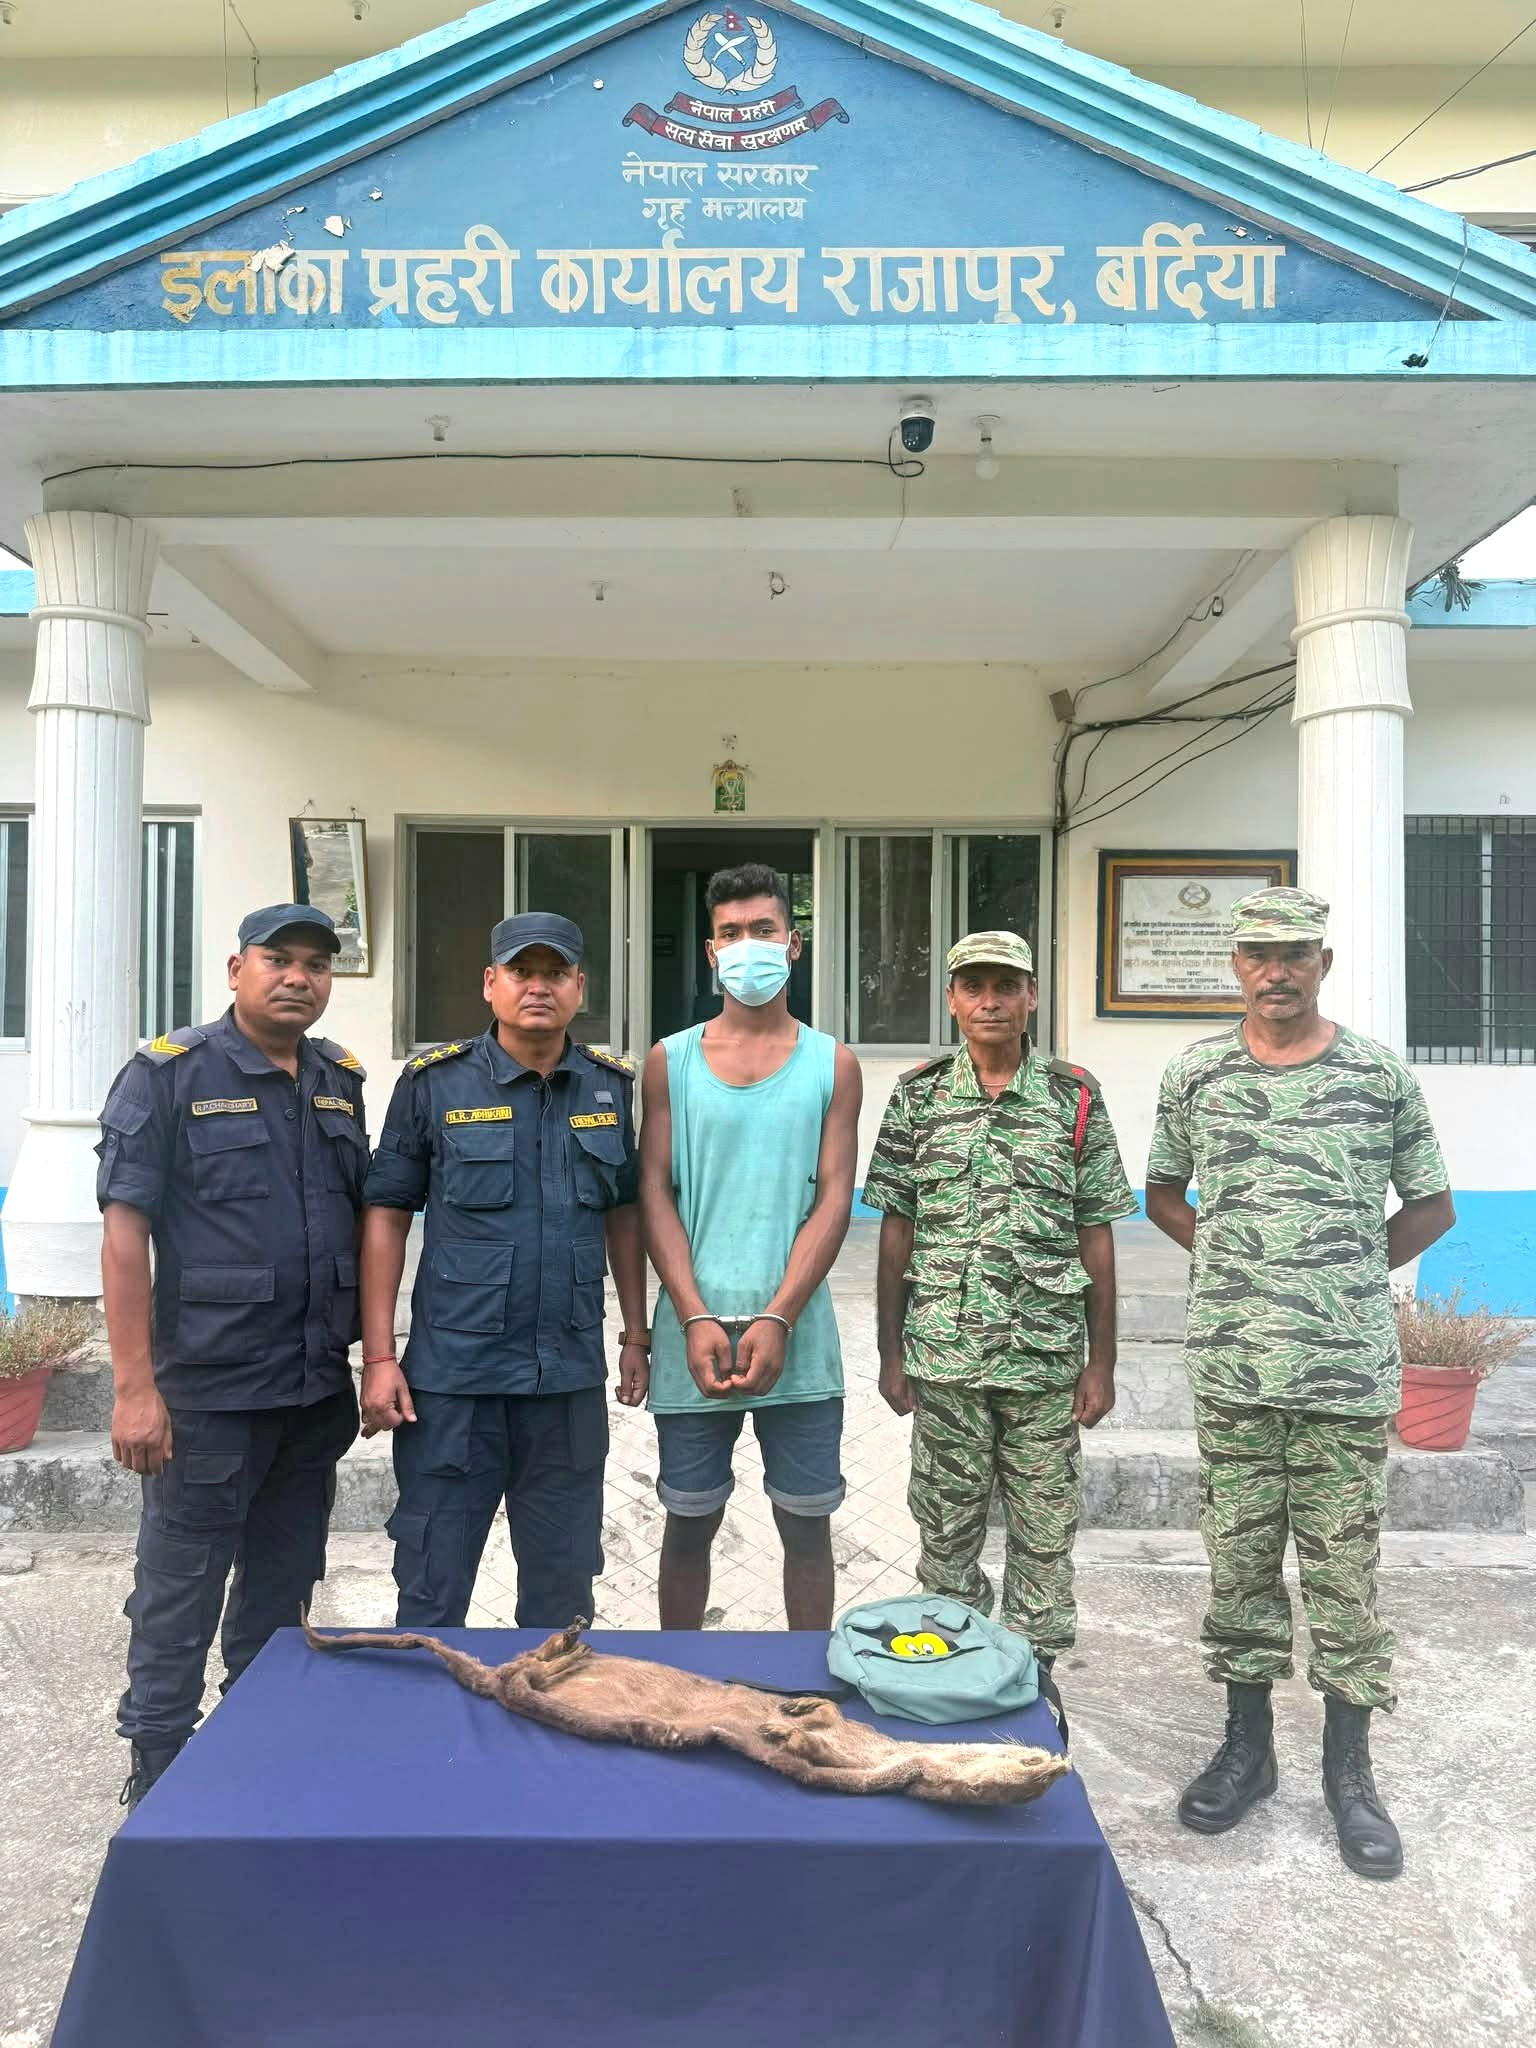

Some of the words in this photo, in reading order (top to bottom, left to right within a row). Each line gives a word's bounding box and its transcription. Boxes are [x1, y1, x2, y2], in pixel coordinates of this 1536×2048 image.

[690, 100, 734, 122] नेपाल
[735, 100, 776, 121] प्रहरी
[665, 120, 699, 145] सत्य
[699, 129, 734, 150] सेवा
[622, 151, 708, 192] नेपाल
[717, 162, 819, 192] सरकार
[642, 197, 692, 230] गृह
[702, 197, 807, 224] मन्त्रालय
[160, 248, 350, 323] इलाका
[360, 224, 520, 324] प्रहरी
[537, 228, 805, 316] कार्यालय
[1096, 222, 1286, 320] बर्दिया
